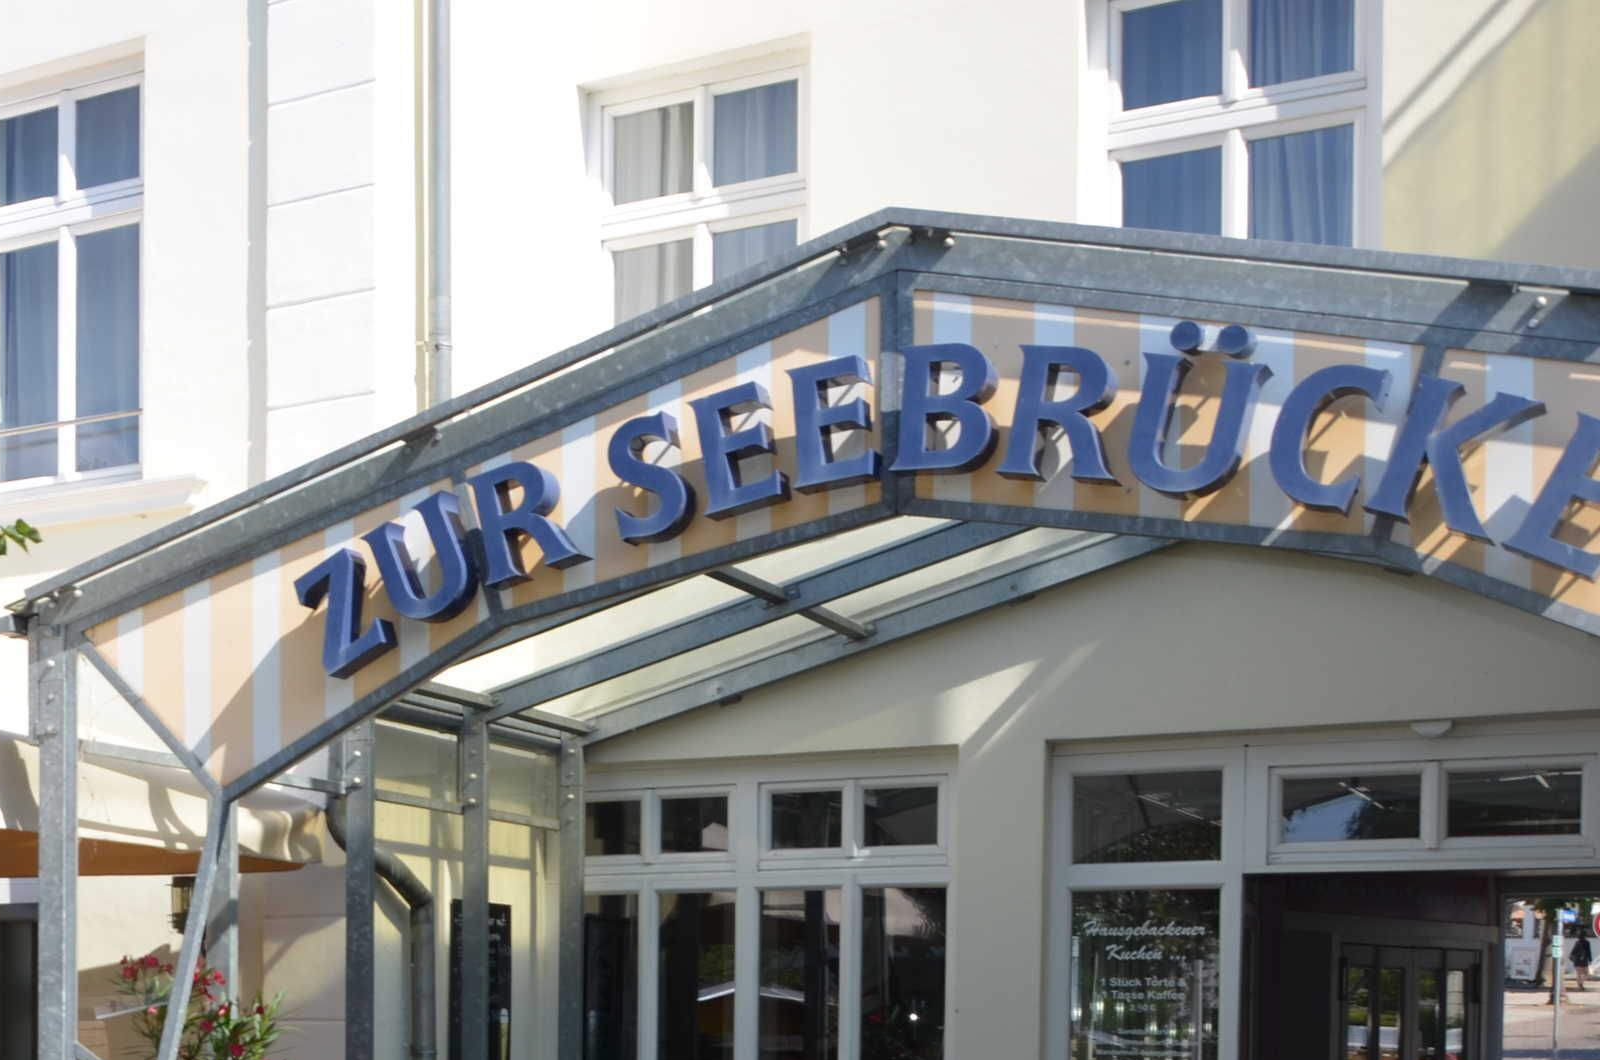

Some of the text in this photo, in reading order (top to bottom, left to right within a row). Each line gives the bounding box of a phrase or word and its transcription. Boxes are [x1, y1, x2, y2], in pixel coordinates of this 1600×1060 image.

[294, 320, 1600, 679] ZUR SEEBRÜCKE
[1083, 920, 1207, 941] Hausgebackener
[1106, 944, 1163, 961] Kuchen
[1109, 977, 1142, 988] Stück
[1146, 976, 1176, 988] Torte
[1111, 990, 1145, 1001] Tasse
[1147, 991, 1185, 1002] Kaffee
